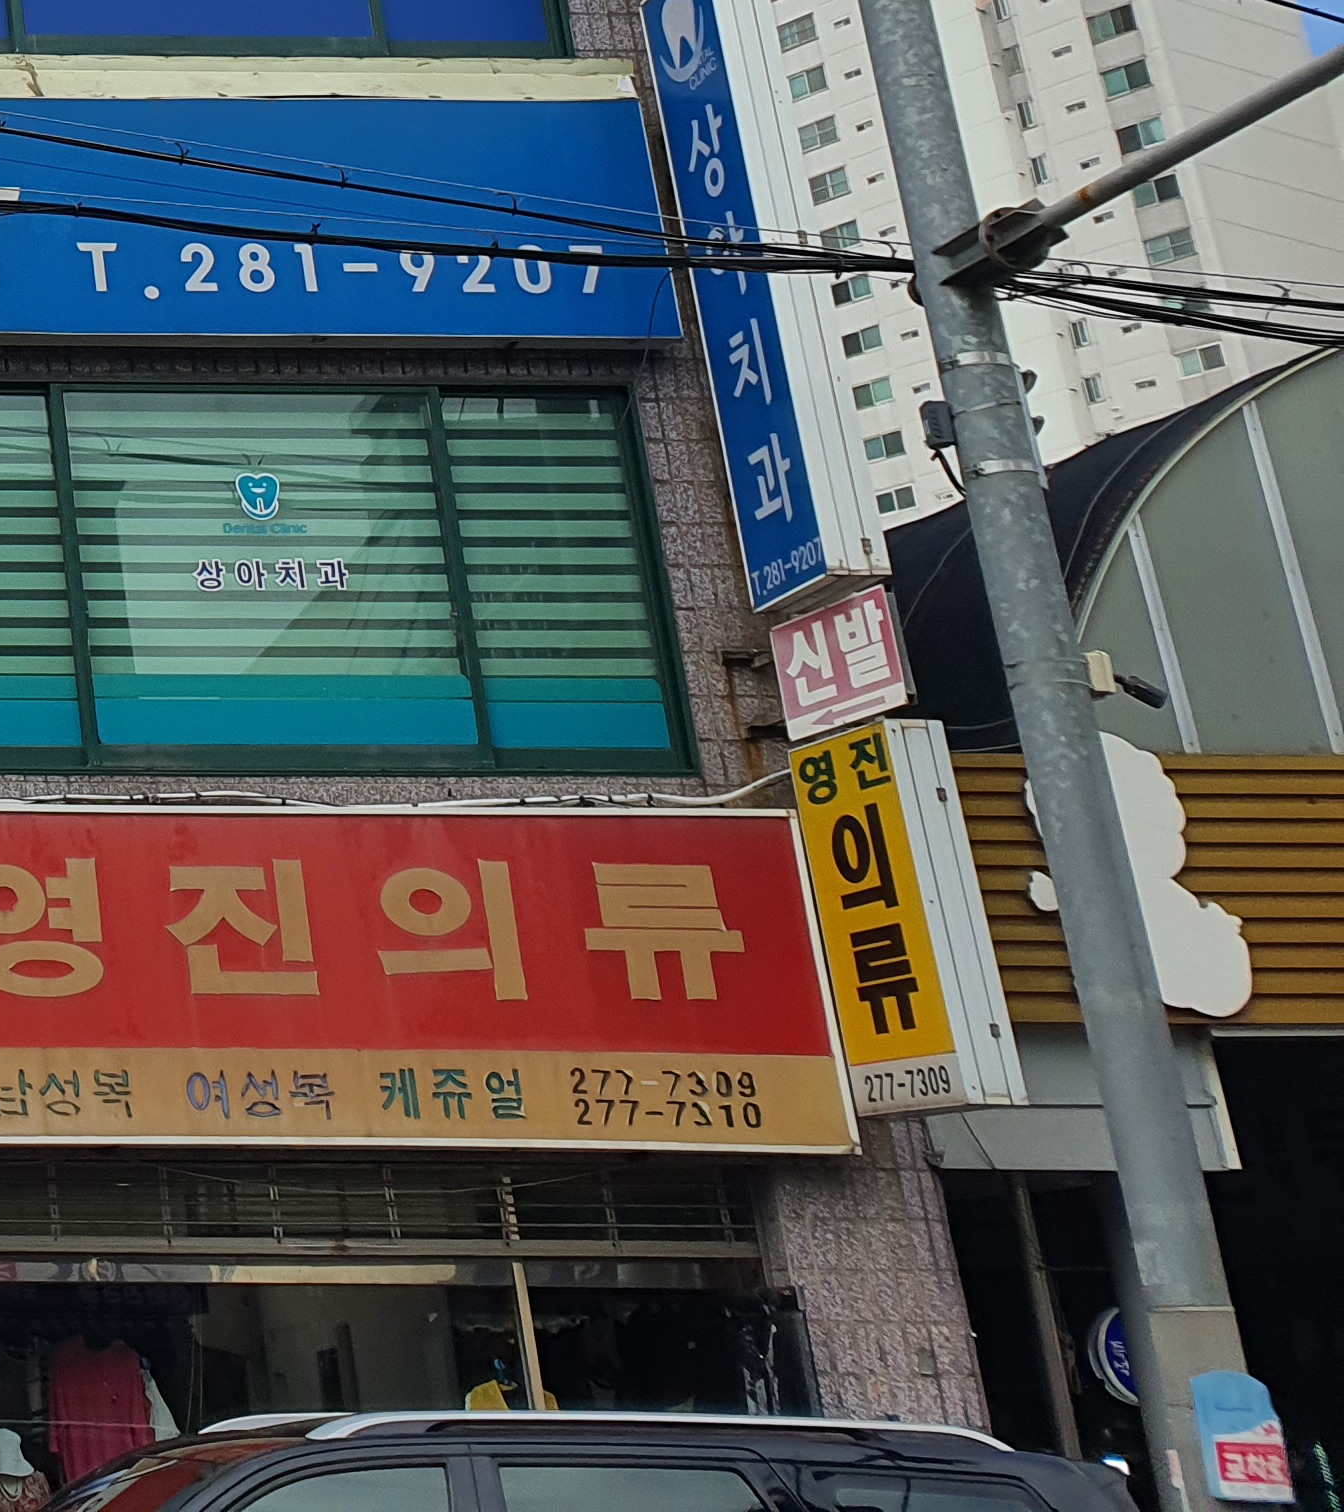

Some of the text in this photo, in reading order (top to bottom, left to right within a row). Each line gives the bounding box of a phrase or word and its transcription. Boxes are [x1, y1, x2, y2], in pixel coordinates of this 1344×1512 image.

[76, 242, 603, 301] T.281-9207
[269, 523, 308, 534] Clinic
[193, 557, 349, 591] 상아치과
[751, 536, 823, 596] T.281-9207
[786, 599, 892, 708] 신발
[798, 731, 892, 806] 영진
[831, 802, 920, 1036] 의류
[186, 1069, 336, 1120] 여성복
[569, 1067, 758, 1098] 277-7309
[863, 1064, 953, 1104] 277-7309
[574, 1098, 763, 1129] 277-7310
